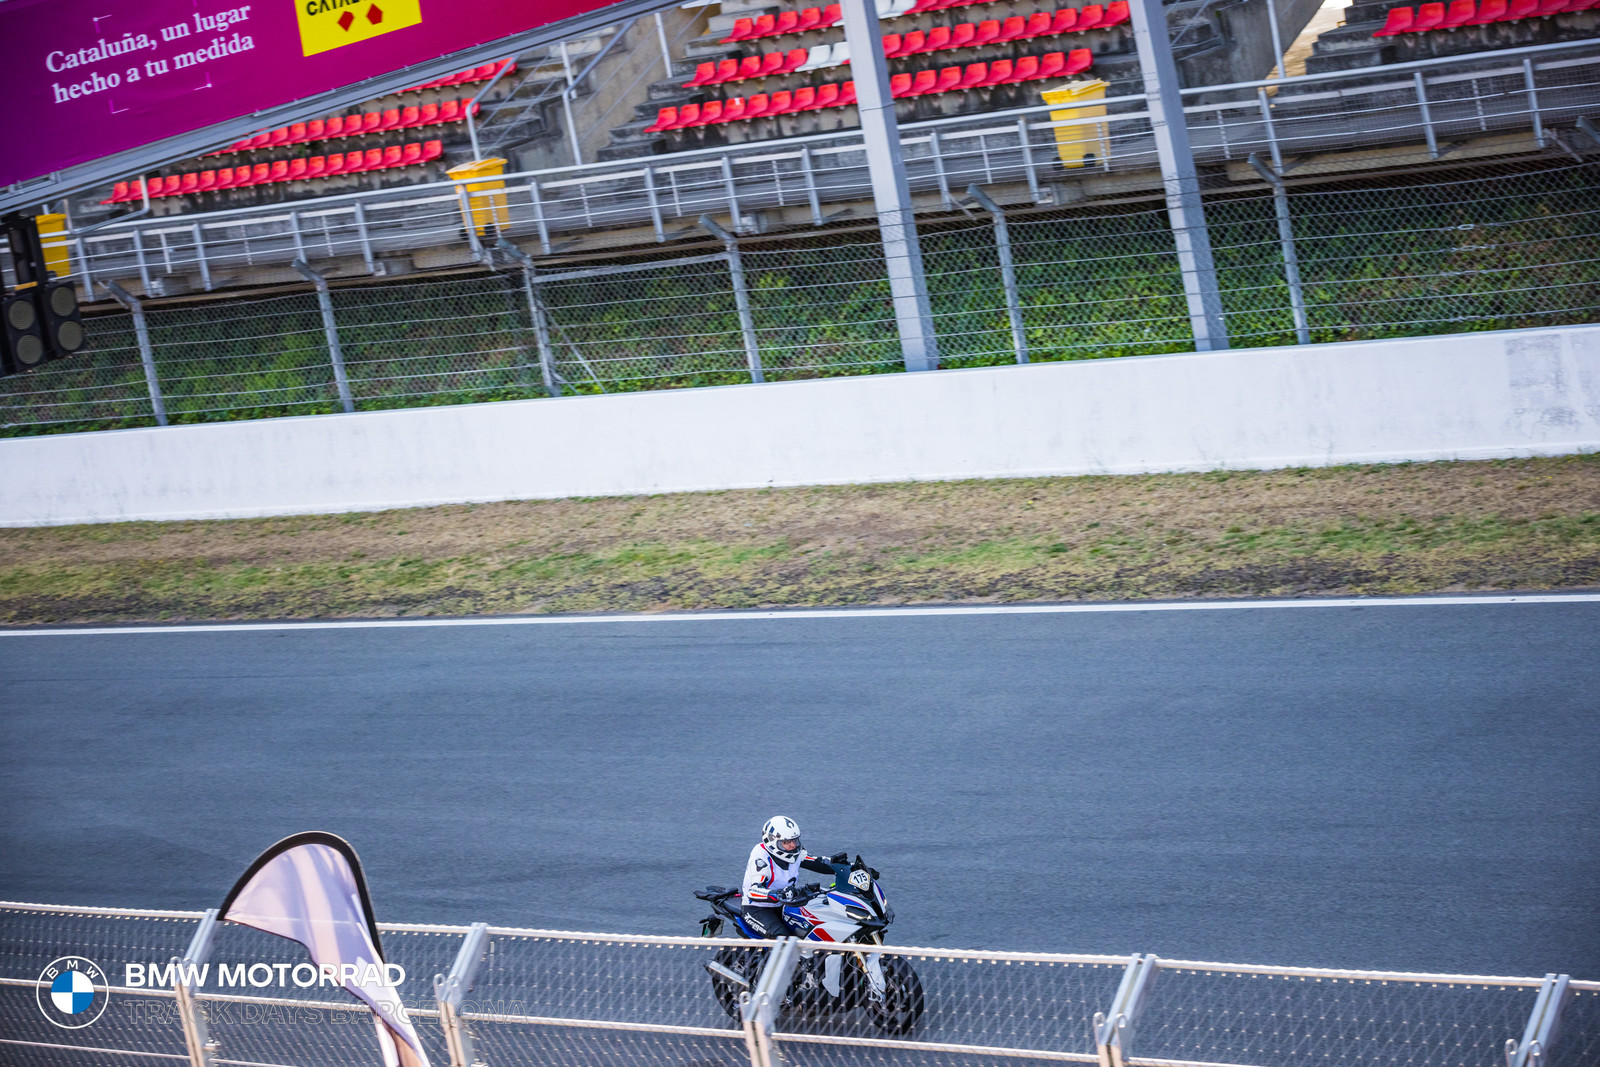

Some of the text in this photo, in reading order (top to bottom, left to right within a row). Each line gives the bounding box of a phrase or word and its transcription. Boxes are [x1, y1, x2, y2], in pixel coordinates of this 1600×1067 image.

[46, 5, 252, 73] Cataluña, un lugar
[51, 33, 256, 104] hecho a tu medida
[853, 872, 868, 884] 175
